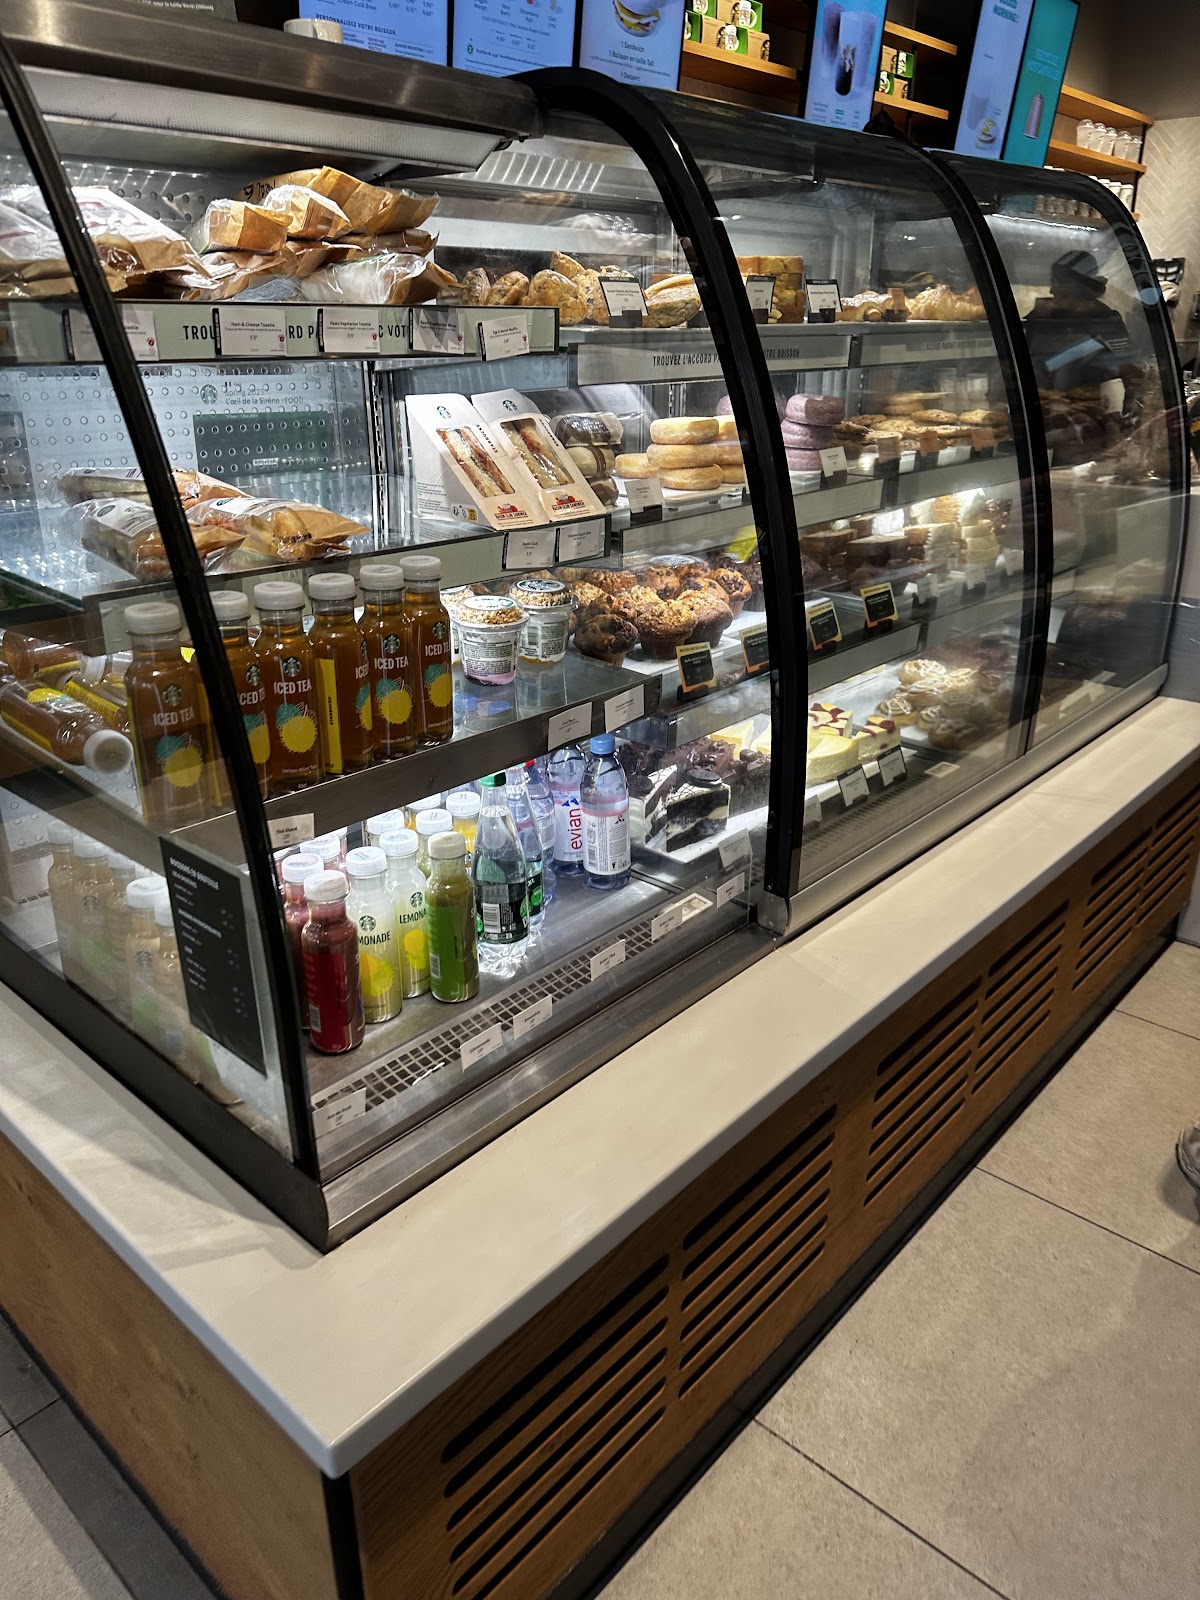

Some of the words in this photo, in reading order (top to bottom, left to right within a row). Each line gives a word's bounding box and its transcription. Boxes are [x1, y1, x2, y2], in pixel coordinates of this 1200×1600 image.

[316, 12, 357, 28] PERSONNALISEZ
[358, 22, 374, 32] VOTRE
[374, 26, 397, 36] BOISSON
[624, 41, 645, 52] Sandwich
[182, 325, 216, 340] TROU
[388, 324, 406, 338] VOT
[653, 355, 680, 366] TROUVEZ
[683, 354, 712, 365] L'ACCORD
[777, 348, 800, 358] BOISSON
[425, 643, 443, 656] ICED
[374, 658, 395, 670] ICED
[395, 656, 409, 669] TEA
[273, 682, 296, 695] ICED
[297, 679, 312, 693] TEA
[238, 691, 259, 706] CED
[153, 712, 178, 726] ICED
[179, 707, 195, 722] TEA
[568, 807, 583, 850] evian
[399, 908, 426, 924] LEMONA
[358, 930, 391, 946] MONADE
